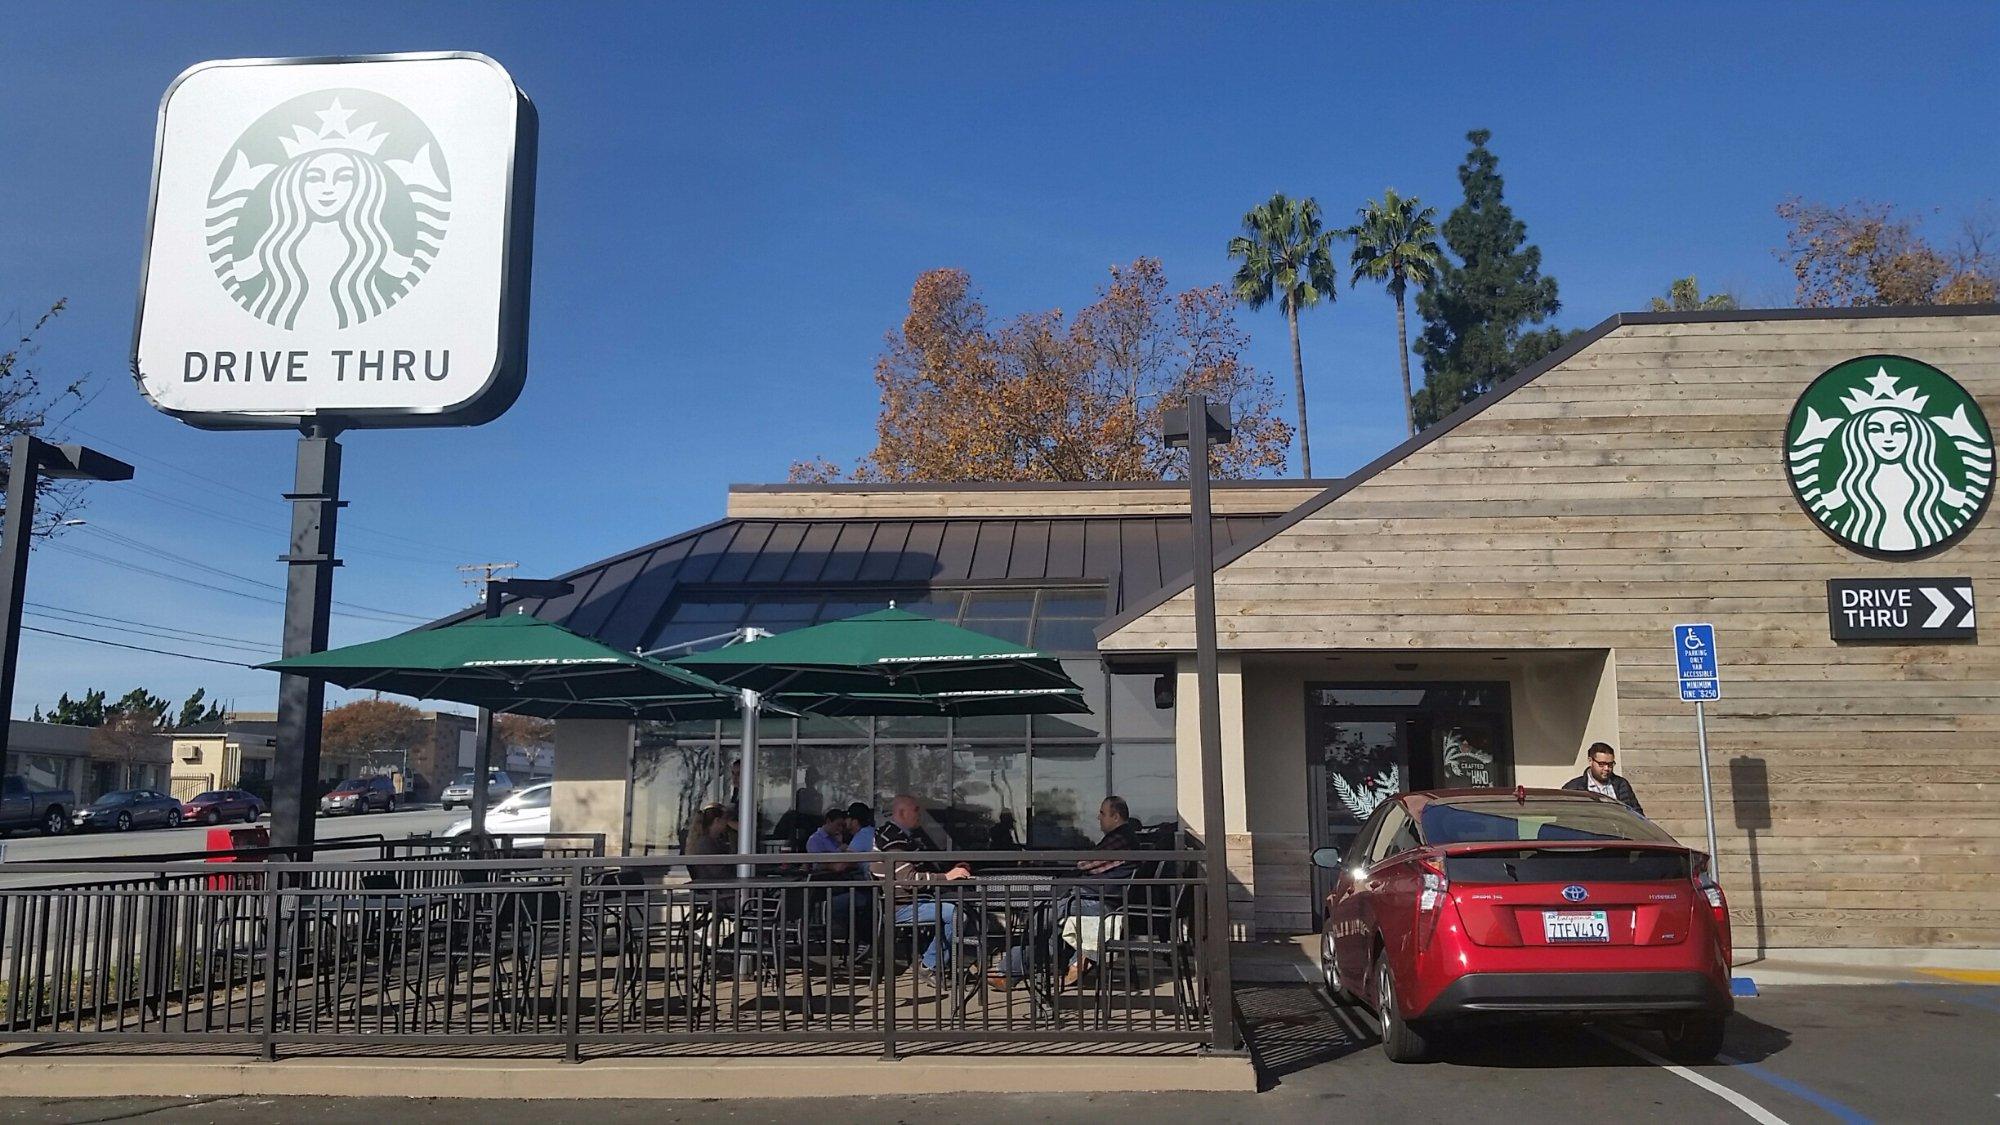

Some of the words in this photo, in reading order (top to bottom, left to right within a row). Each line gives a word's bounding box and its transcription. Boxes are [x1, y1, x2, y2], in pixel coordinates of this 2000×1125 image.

[183, 350, 309, 383] DRIVE
[331, 350, 450, 382] THRU
[1841, 588, 1912, 608] DRIVE
[1843, 609, 1908, 628] THRU
[878, 655, 973, 663] STARBUCKS
[979, 652, 1038, 660] COFFEE
[1684, 649, 1708, 657] PARKING
[1686, 681, 1712, 689] MINIMUM
[1683, 690, 1697, 698] FINE
[1471, 770, 1489, 785] HAND
[1549, 922, 1605, 938] 7TFV419
